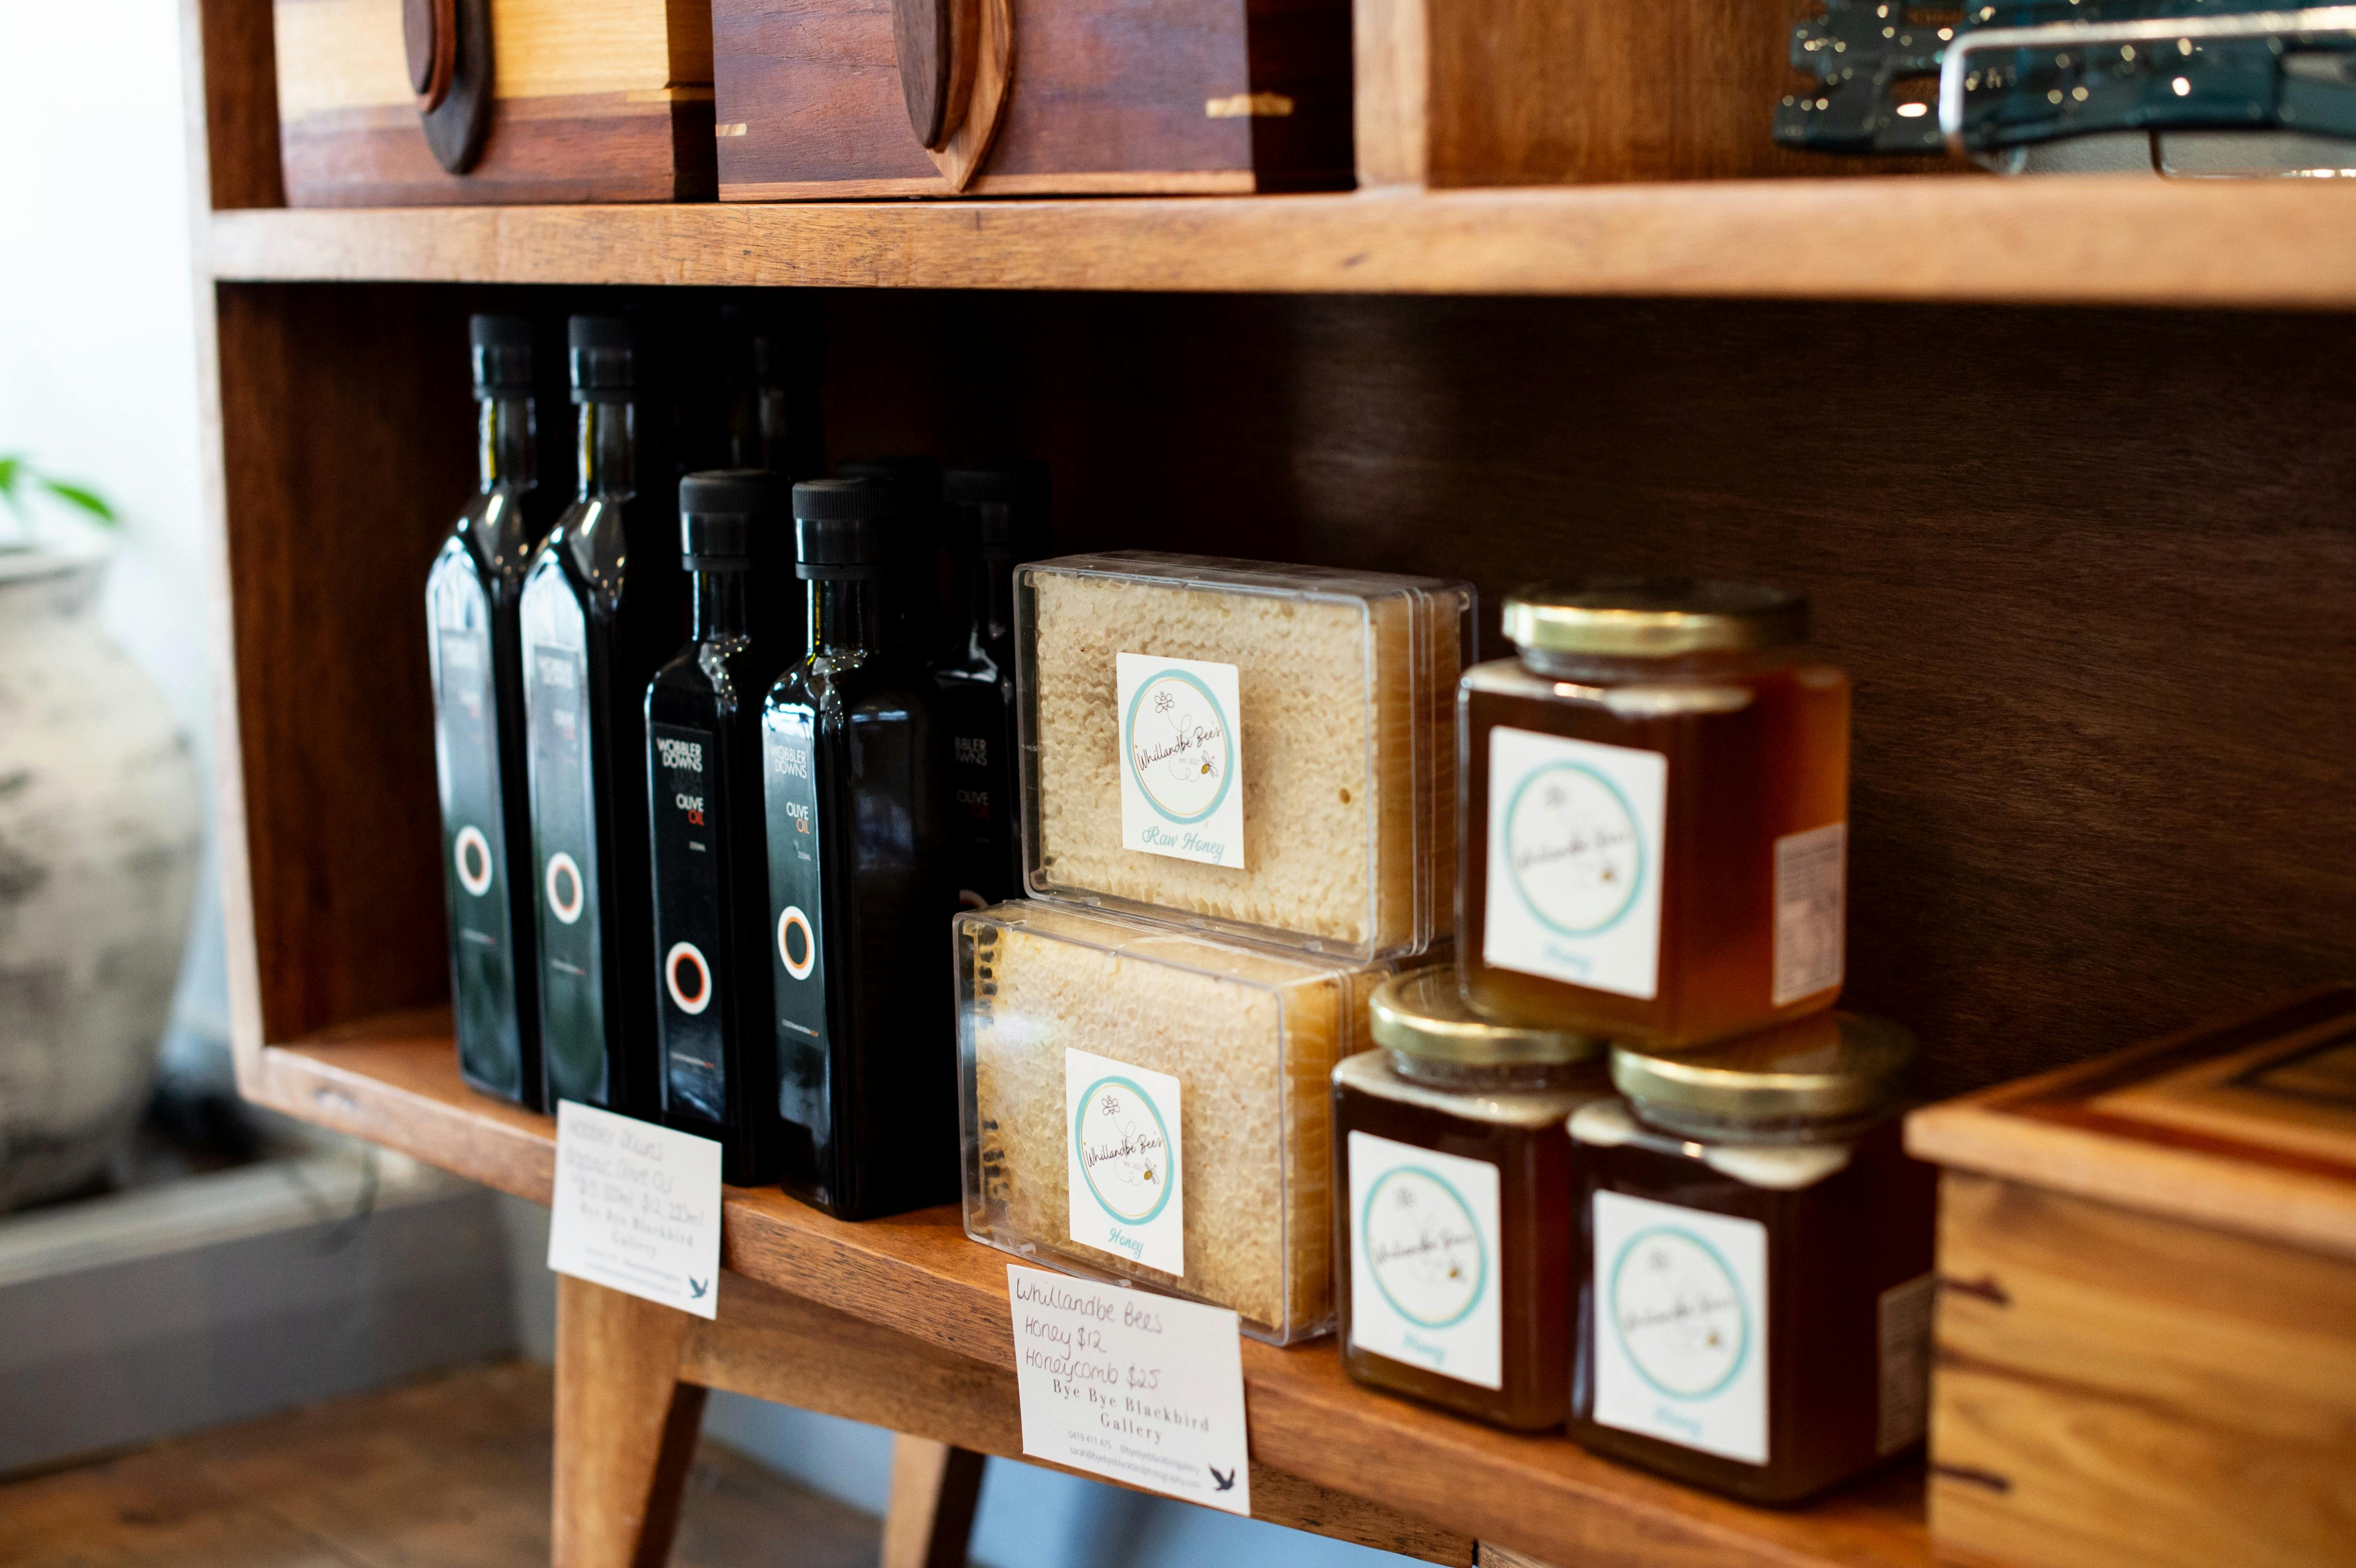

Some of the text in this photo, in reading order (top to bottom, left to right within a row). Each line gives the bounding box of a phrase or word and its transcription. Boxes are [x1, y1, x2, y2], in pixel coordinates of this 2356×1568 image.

[656, 737, 702, 755] WOBBLER
[771, 745, 806, 765] WOBBLER
[662, 751, 703, 773] DOWNS
[775, 759, 807, 779] DOWNS
[675, 793, 704, 813] OLIVE
[786, 802, 809, 820] OLIVE
[687, 809, 705, 826] OIL
[796, 818, 810, 834] OIL
[1142, 825, 1225, 864] Raw Honey
[1107, 1227, 1144, 1260] Honey
[1016, 1277, 1164, 1334] Whillandbe Bees
[1025, 1315, 1107, 1360] Honey $12
[1026, 1347, 1162, 1390] Honeycomb $25
[1053, 1378, 1210, 1432] Bye Bye Blackbird
[1100, 1412, 1163, 1445] Gallery
